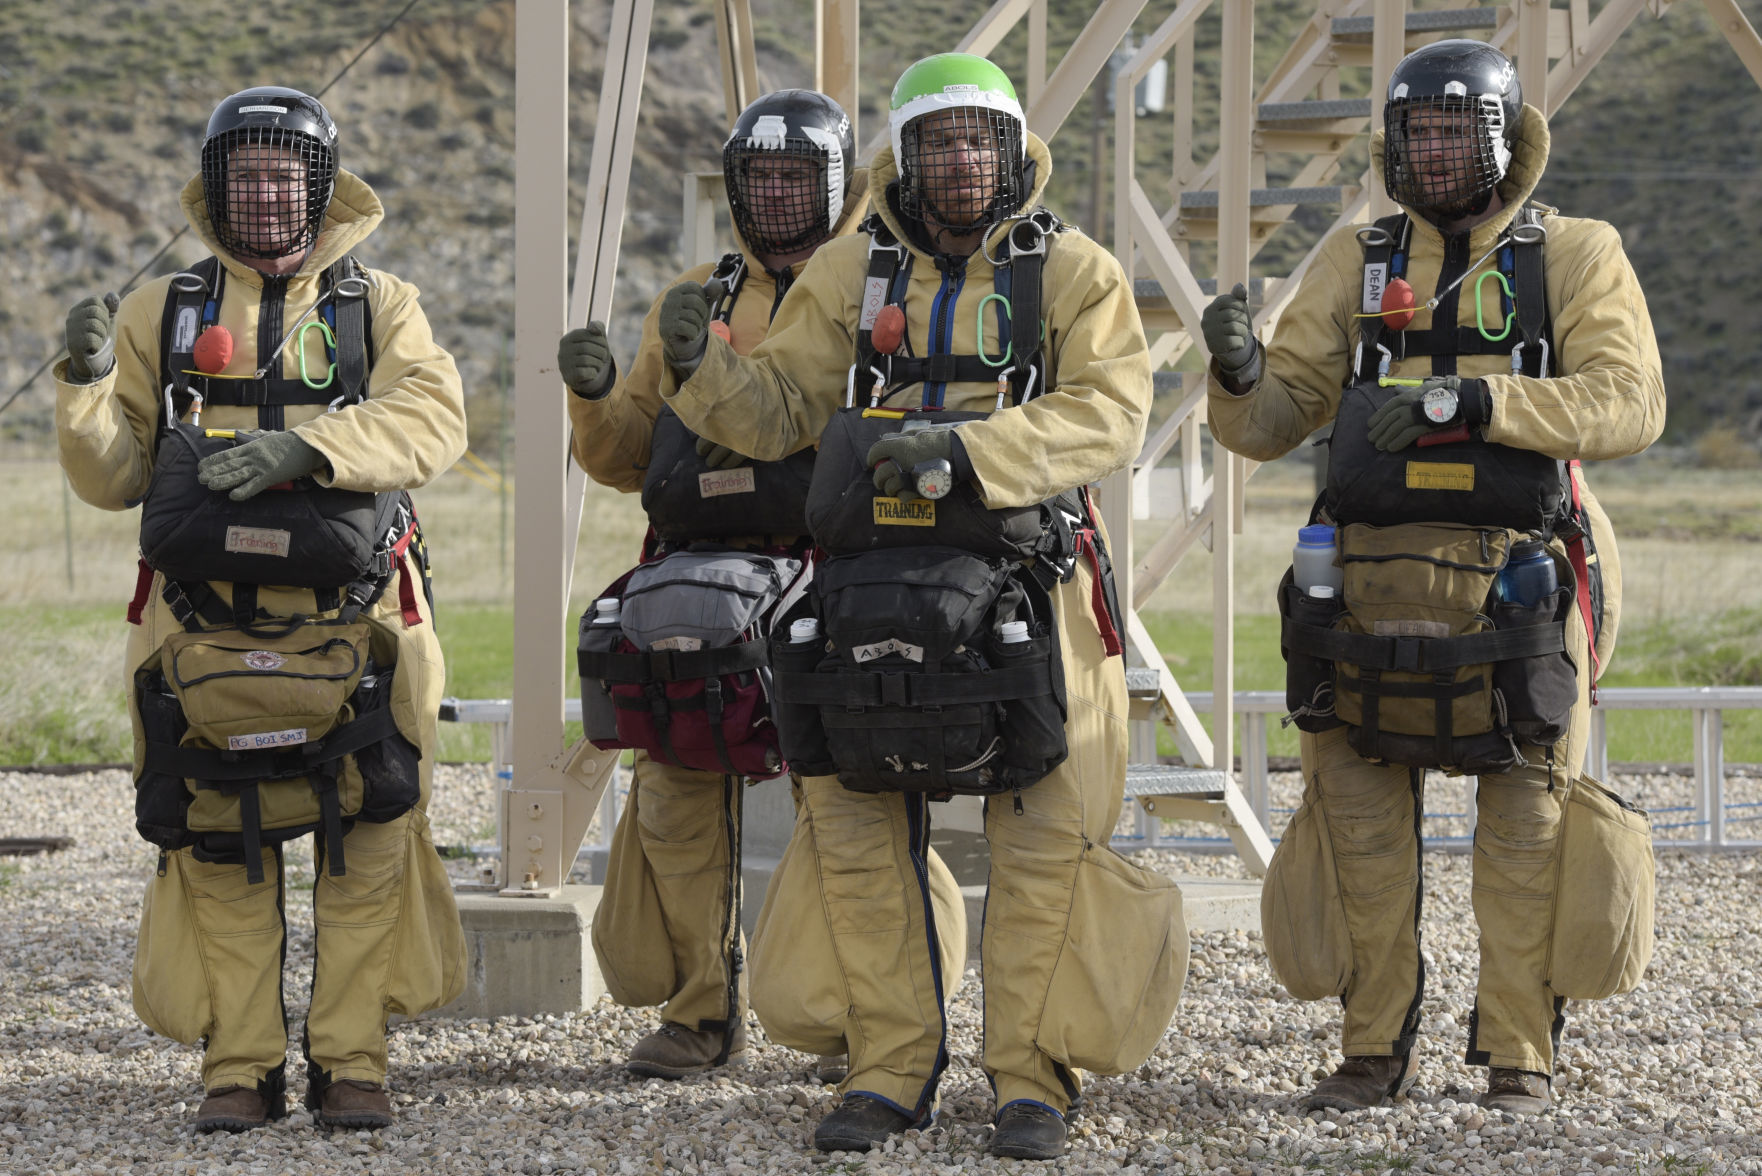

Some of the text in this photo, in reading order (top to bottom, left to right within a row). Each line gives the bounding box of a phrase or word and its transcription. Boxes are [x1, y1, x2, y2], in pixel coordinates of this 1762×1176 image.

[1369, 268, 1382, 301] DEAN
[865, 281, 885, 326] ABOLS
[255, 735, 277, 747] BOI
[279, 731, 304, 743] SMJ
